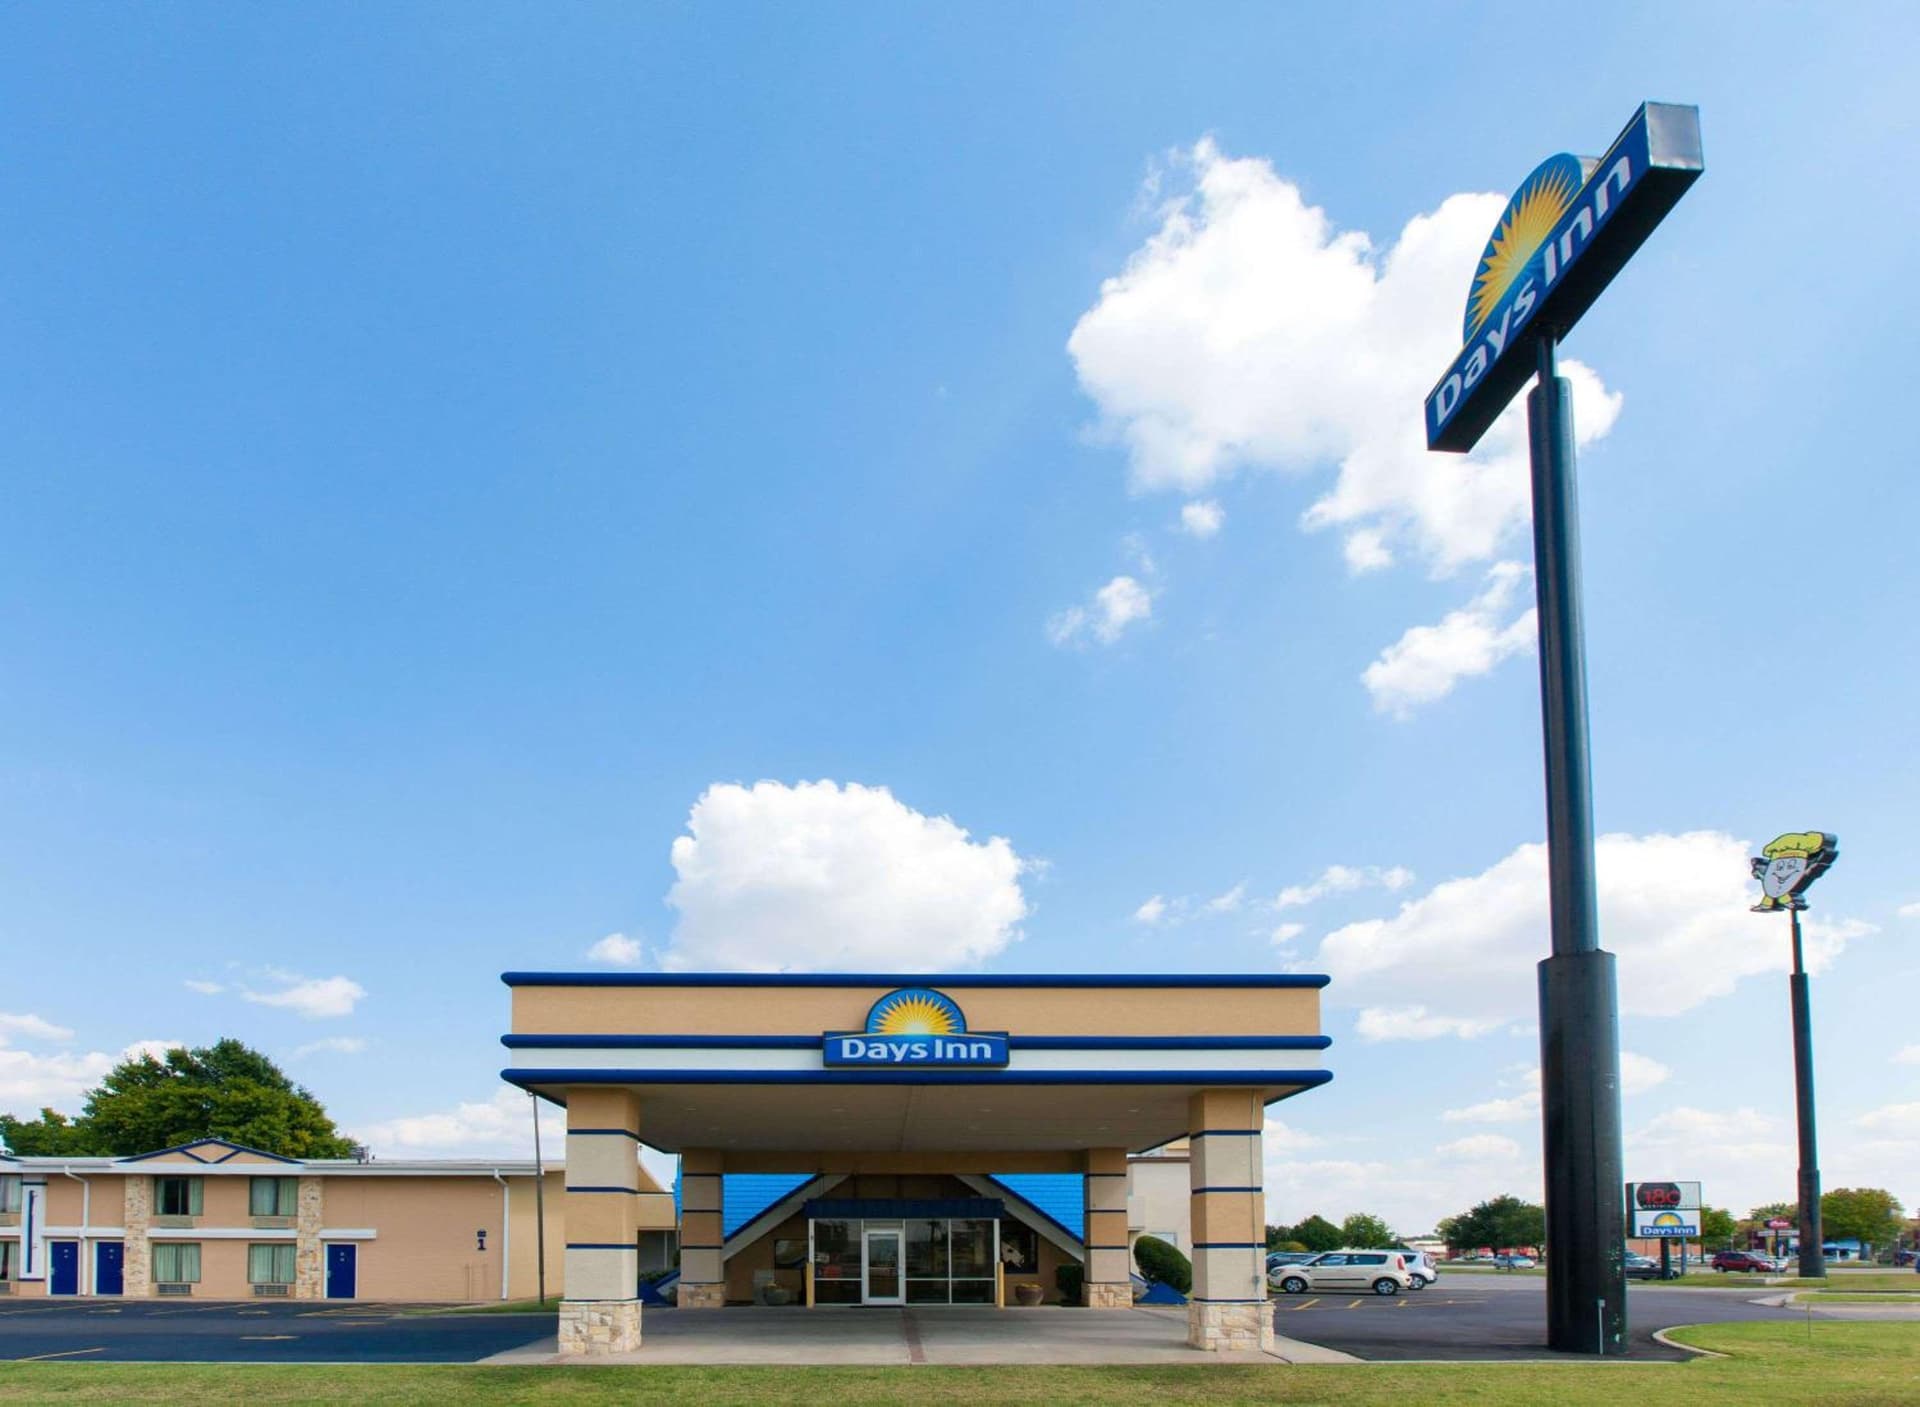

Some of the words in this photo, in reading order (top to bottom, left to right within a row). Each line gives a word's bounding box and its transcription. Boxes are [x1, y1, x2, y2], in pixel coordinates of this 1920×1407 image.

[1435, 276, 1537, 427] Days
[1544, 155, 1632, 287] Inn
[841, 1039, 929, 1062] Days
[935, 1039, 992, 1059] Inn
[1643, 1227, 1673, 1236] Days
[1674, 1227, 1694, 1235] Inn
